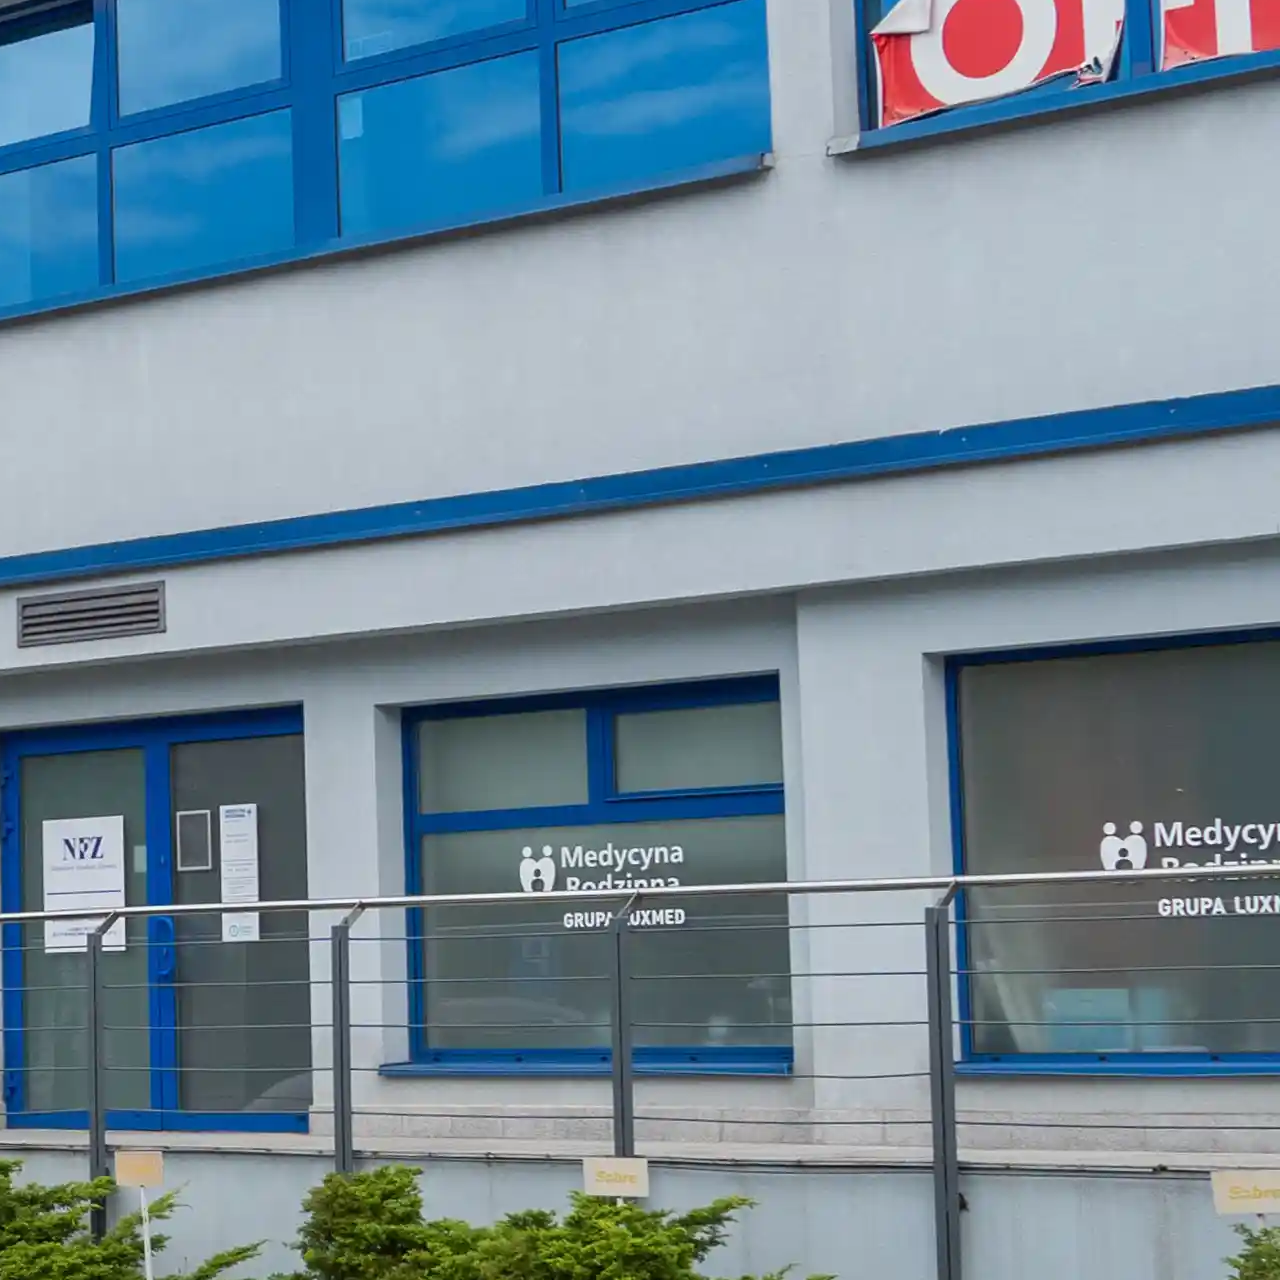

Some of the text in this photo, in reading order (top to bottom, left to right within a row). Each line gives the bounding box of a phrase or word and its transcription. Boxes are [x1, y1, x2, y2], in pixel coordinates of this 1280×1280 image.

[1153, 817, 1280, 852] Medycy
[62, 836, 104, 861] NFZ
[560, 842, 684, 872] Medycyna
[1157, 894, 1280, 917] GRUPA LUX
